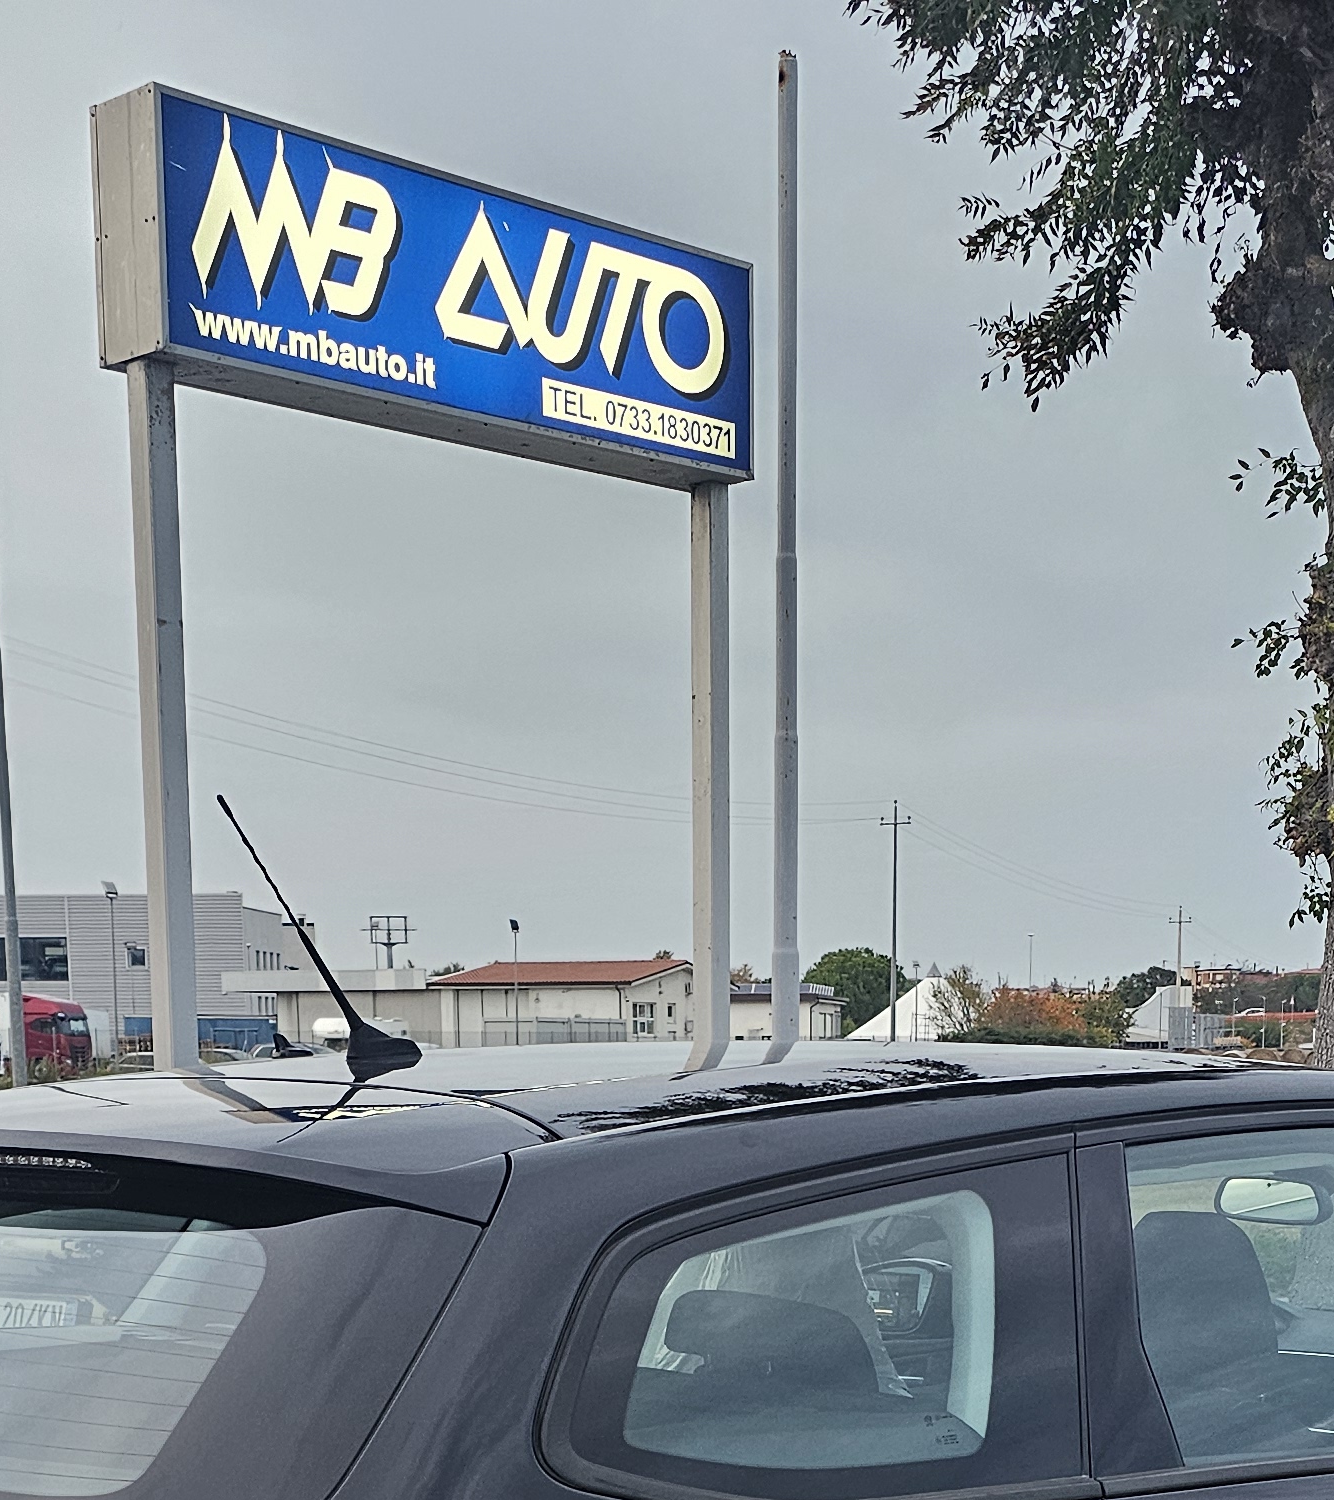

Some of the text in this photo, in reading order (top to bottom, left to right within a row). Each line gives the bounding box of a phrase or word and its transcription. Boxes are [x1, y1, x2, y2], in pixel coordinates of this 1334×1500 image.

[191, 112, 727, 397] MB AUTO
[189, 303, 436, 390] www.mbauto.it
[548, 385, 734, 454] TEL. 0733.1830371
